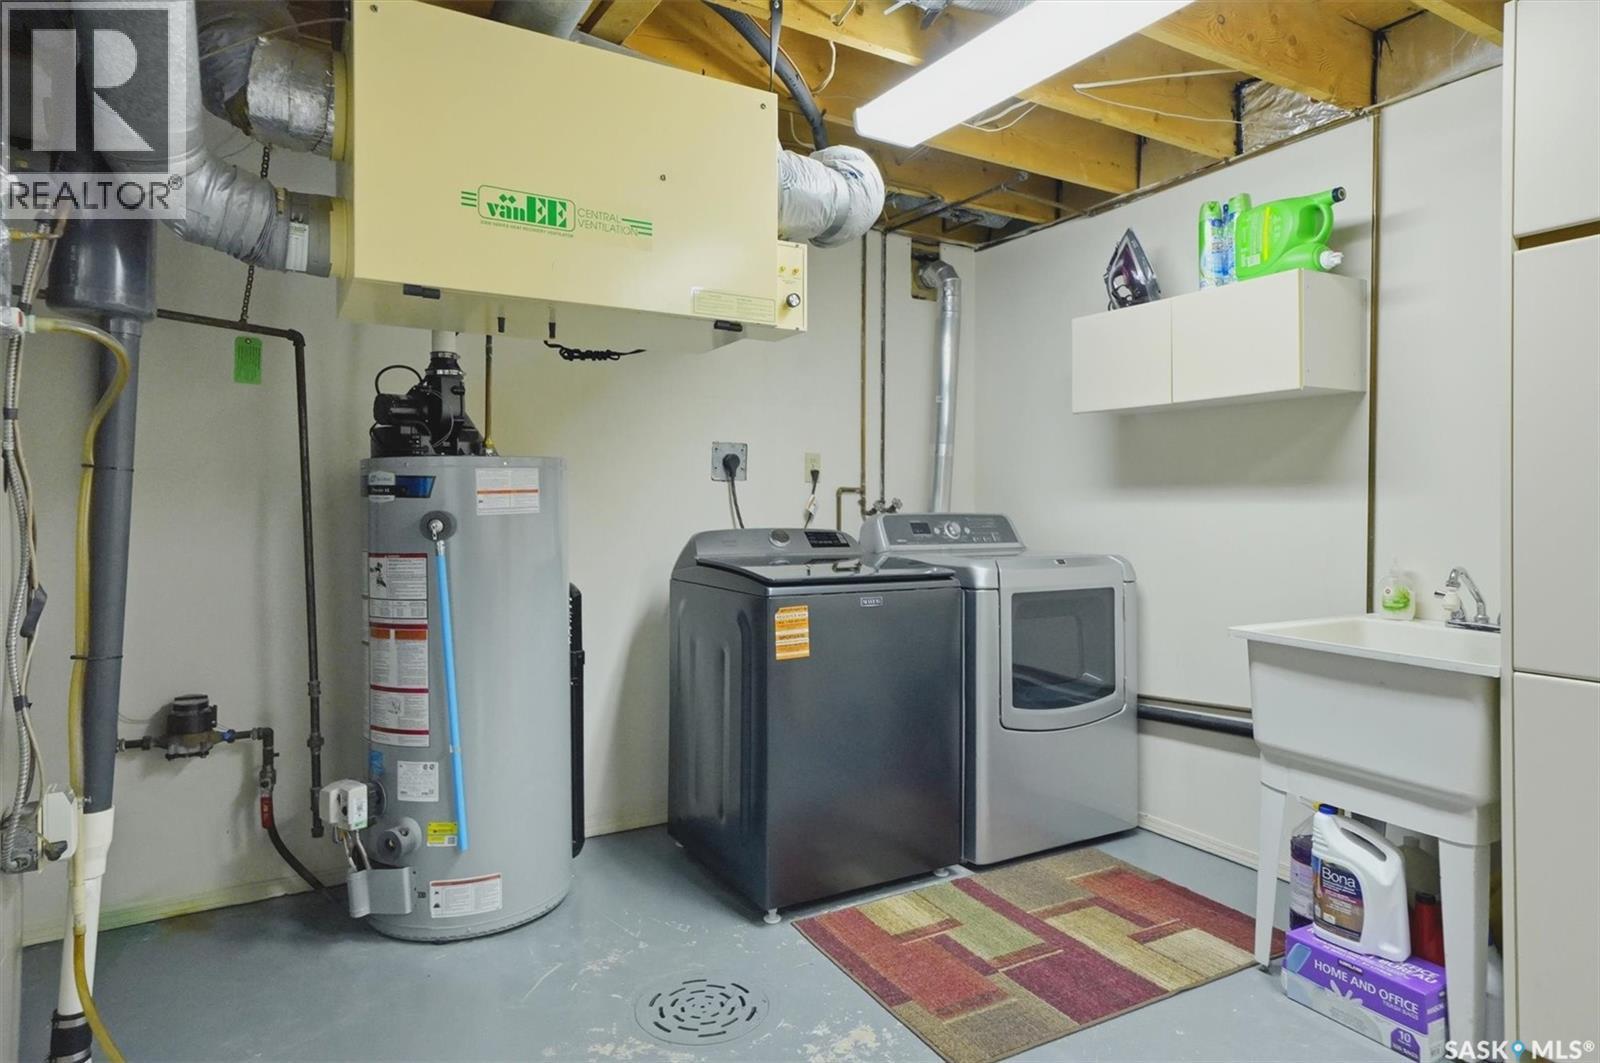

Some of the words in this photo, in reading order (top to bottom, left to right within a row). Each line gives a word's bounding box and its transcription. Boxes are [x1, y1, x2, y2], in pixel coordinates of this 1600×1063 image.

[486, 194, 567, 228] vänEE
[577, 208, 621, 224] CENTRAL
[577, 218, 638, 236] VENTILATION
[1322, 866, 1356, 888] Bona
[1314, 959, 1348, 983] HOME
[1350, 976, 1377, 995] AND
[1378, 988, 1419, 1015] OFFICE
[1397, 1030, 1411, 1043] 10
